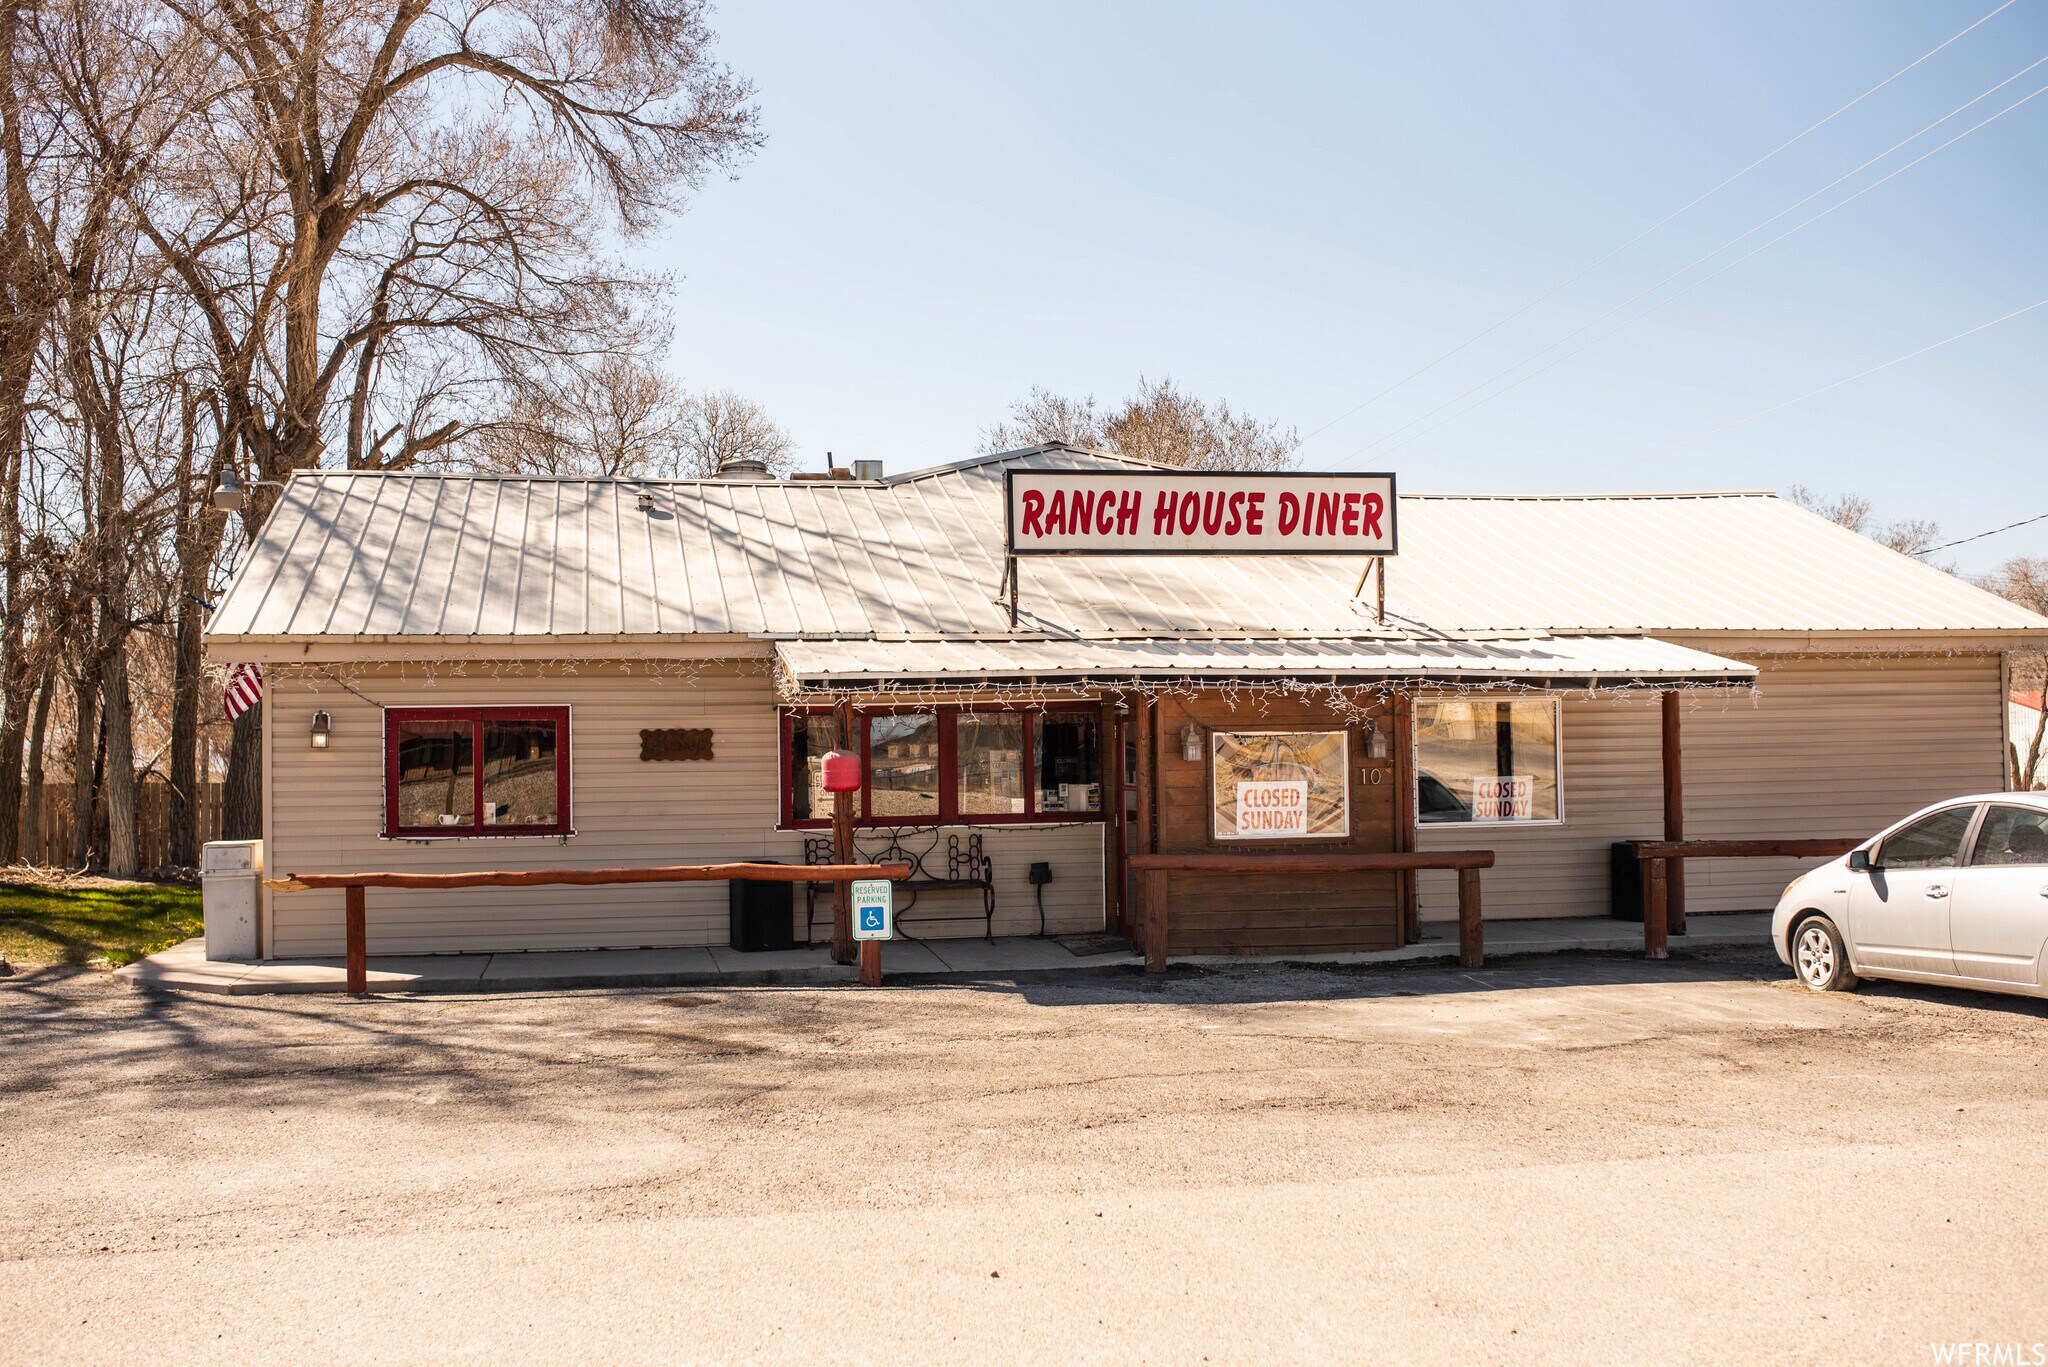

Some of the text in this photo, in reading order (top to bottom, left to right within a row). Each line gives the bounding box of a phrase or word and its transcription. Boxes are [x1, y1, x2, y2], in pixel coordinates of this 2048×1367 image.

[1022, 489, 1384, 540] RANCH HOUSE DINER
[1361, 768, 1381, 785] 10
[1243, 788, 1301, 808] CLOSED
[1478, 781, 1527, 799] CLOSED
[1475, 800, 1529, 818] SUNDAY
[1241, 811, 1303, 831] SUNDAY
[855, 886, 888, 895] RESERVED
[857, 895, 887, 904] PARKING
